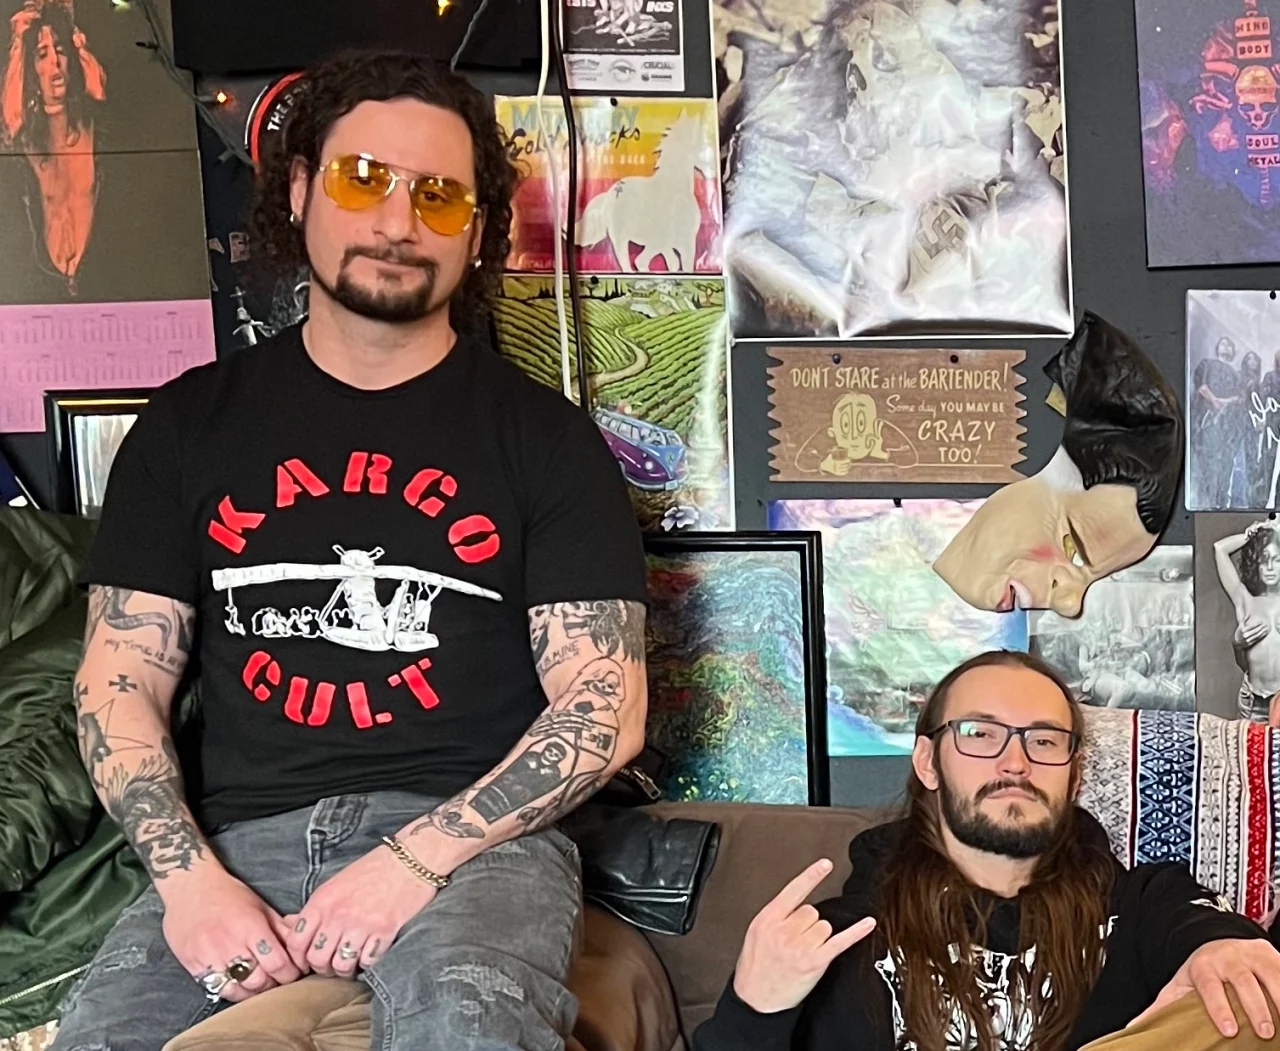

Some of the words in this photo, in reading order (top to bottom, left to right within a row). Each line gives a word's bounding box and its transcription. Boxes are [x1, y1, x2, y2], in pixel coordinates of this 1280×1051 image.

[1239, 45, 1269, 56] BODY
[1247, 138, 1279, 148] SOUL
[1248, 156, 1280, 166] METAL
[835, 367, 880, 389] STARE
[881, 377, 896, 389] at
[898, 374, 917, 389] the
[919, 362, 1009, 393] BARTENDER!
[886, 394, 916, 414] Some
[917, 401, 936, 418] day
[939, 402, 964, 413] YOU
[966, 402, 990, 413] MAY
[992, 402, 1004, 413] BE
[917, 419, 996, 443] CRAZY
[938, 444, 983, 464] TOO!
[242, 650, 440, 729] CULT
